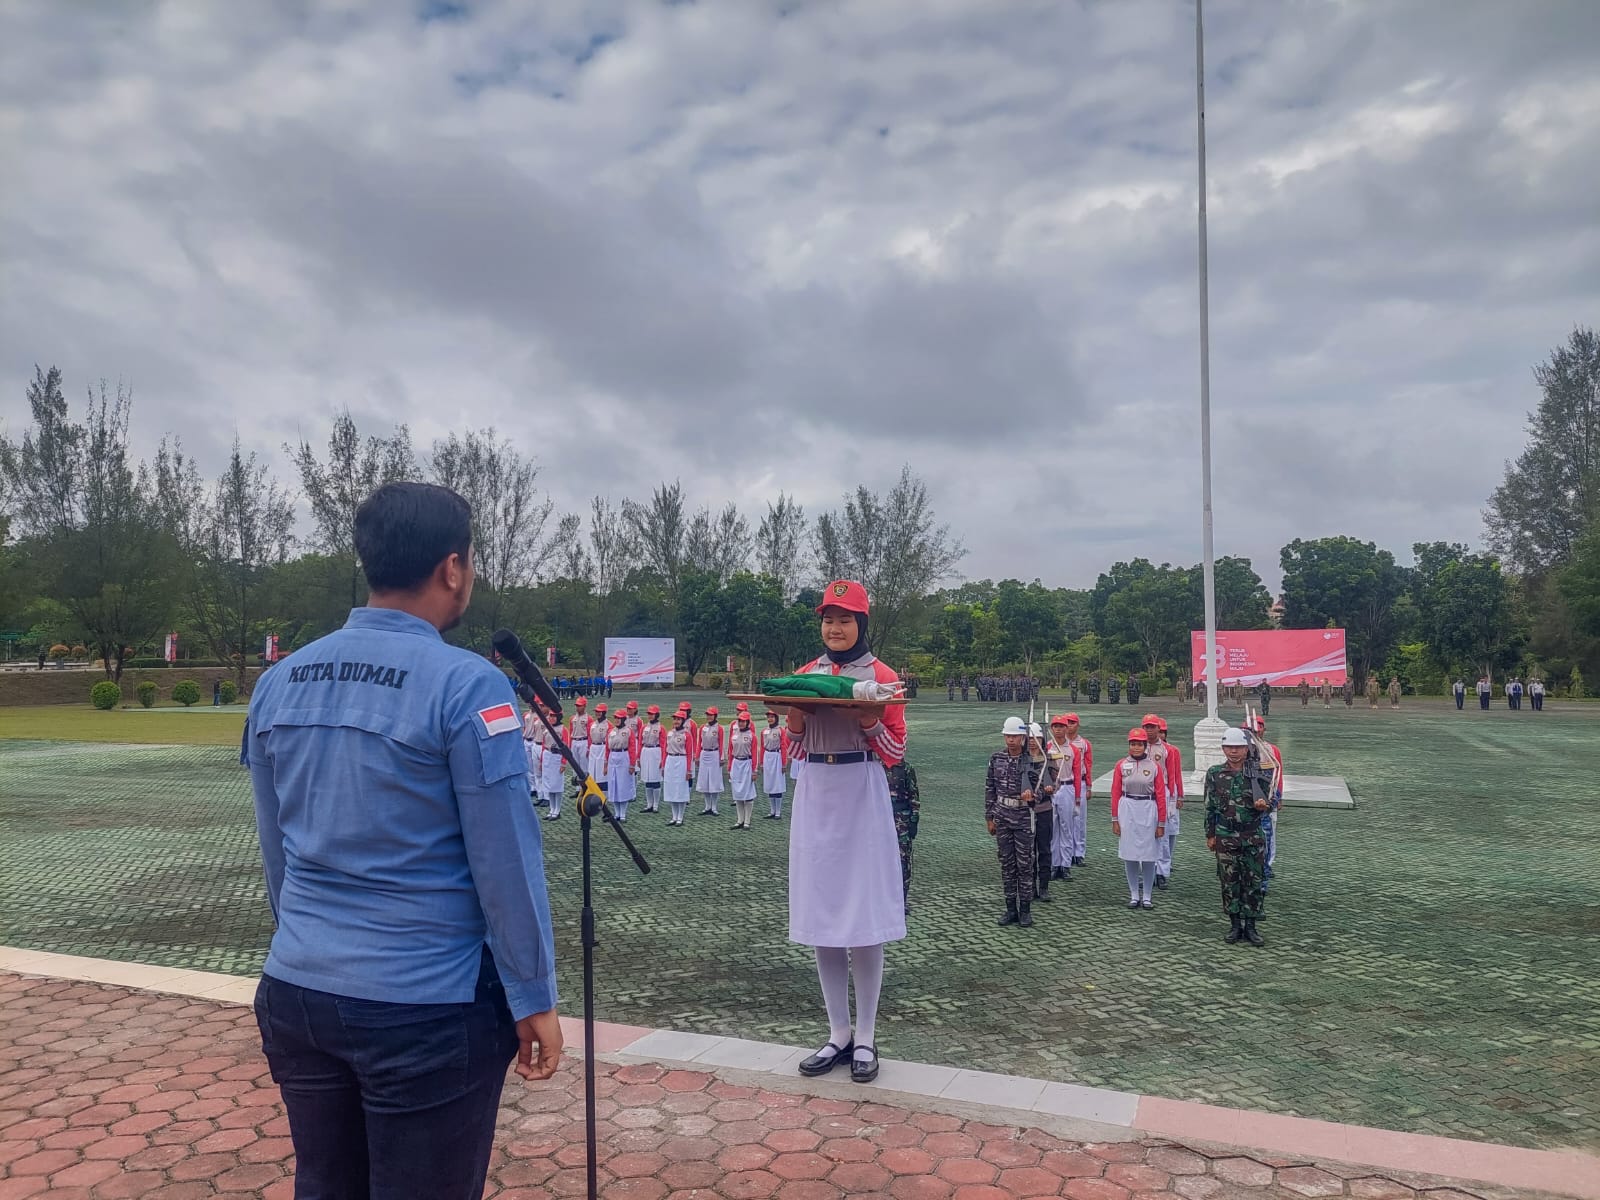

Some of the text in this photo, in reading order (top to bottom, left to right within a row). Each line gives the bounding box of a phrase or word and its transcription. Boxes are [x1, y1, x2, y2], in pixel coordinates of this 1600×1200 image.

[608, 651, 626, 670] 78
[288, 662, 408, 689] KOTA DUMAI
